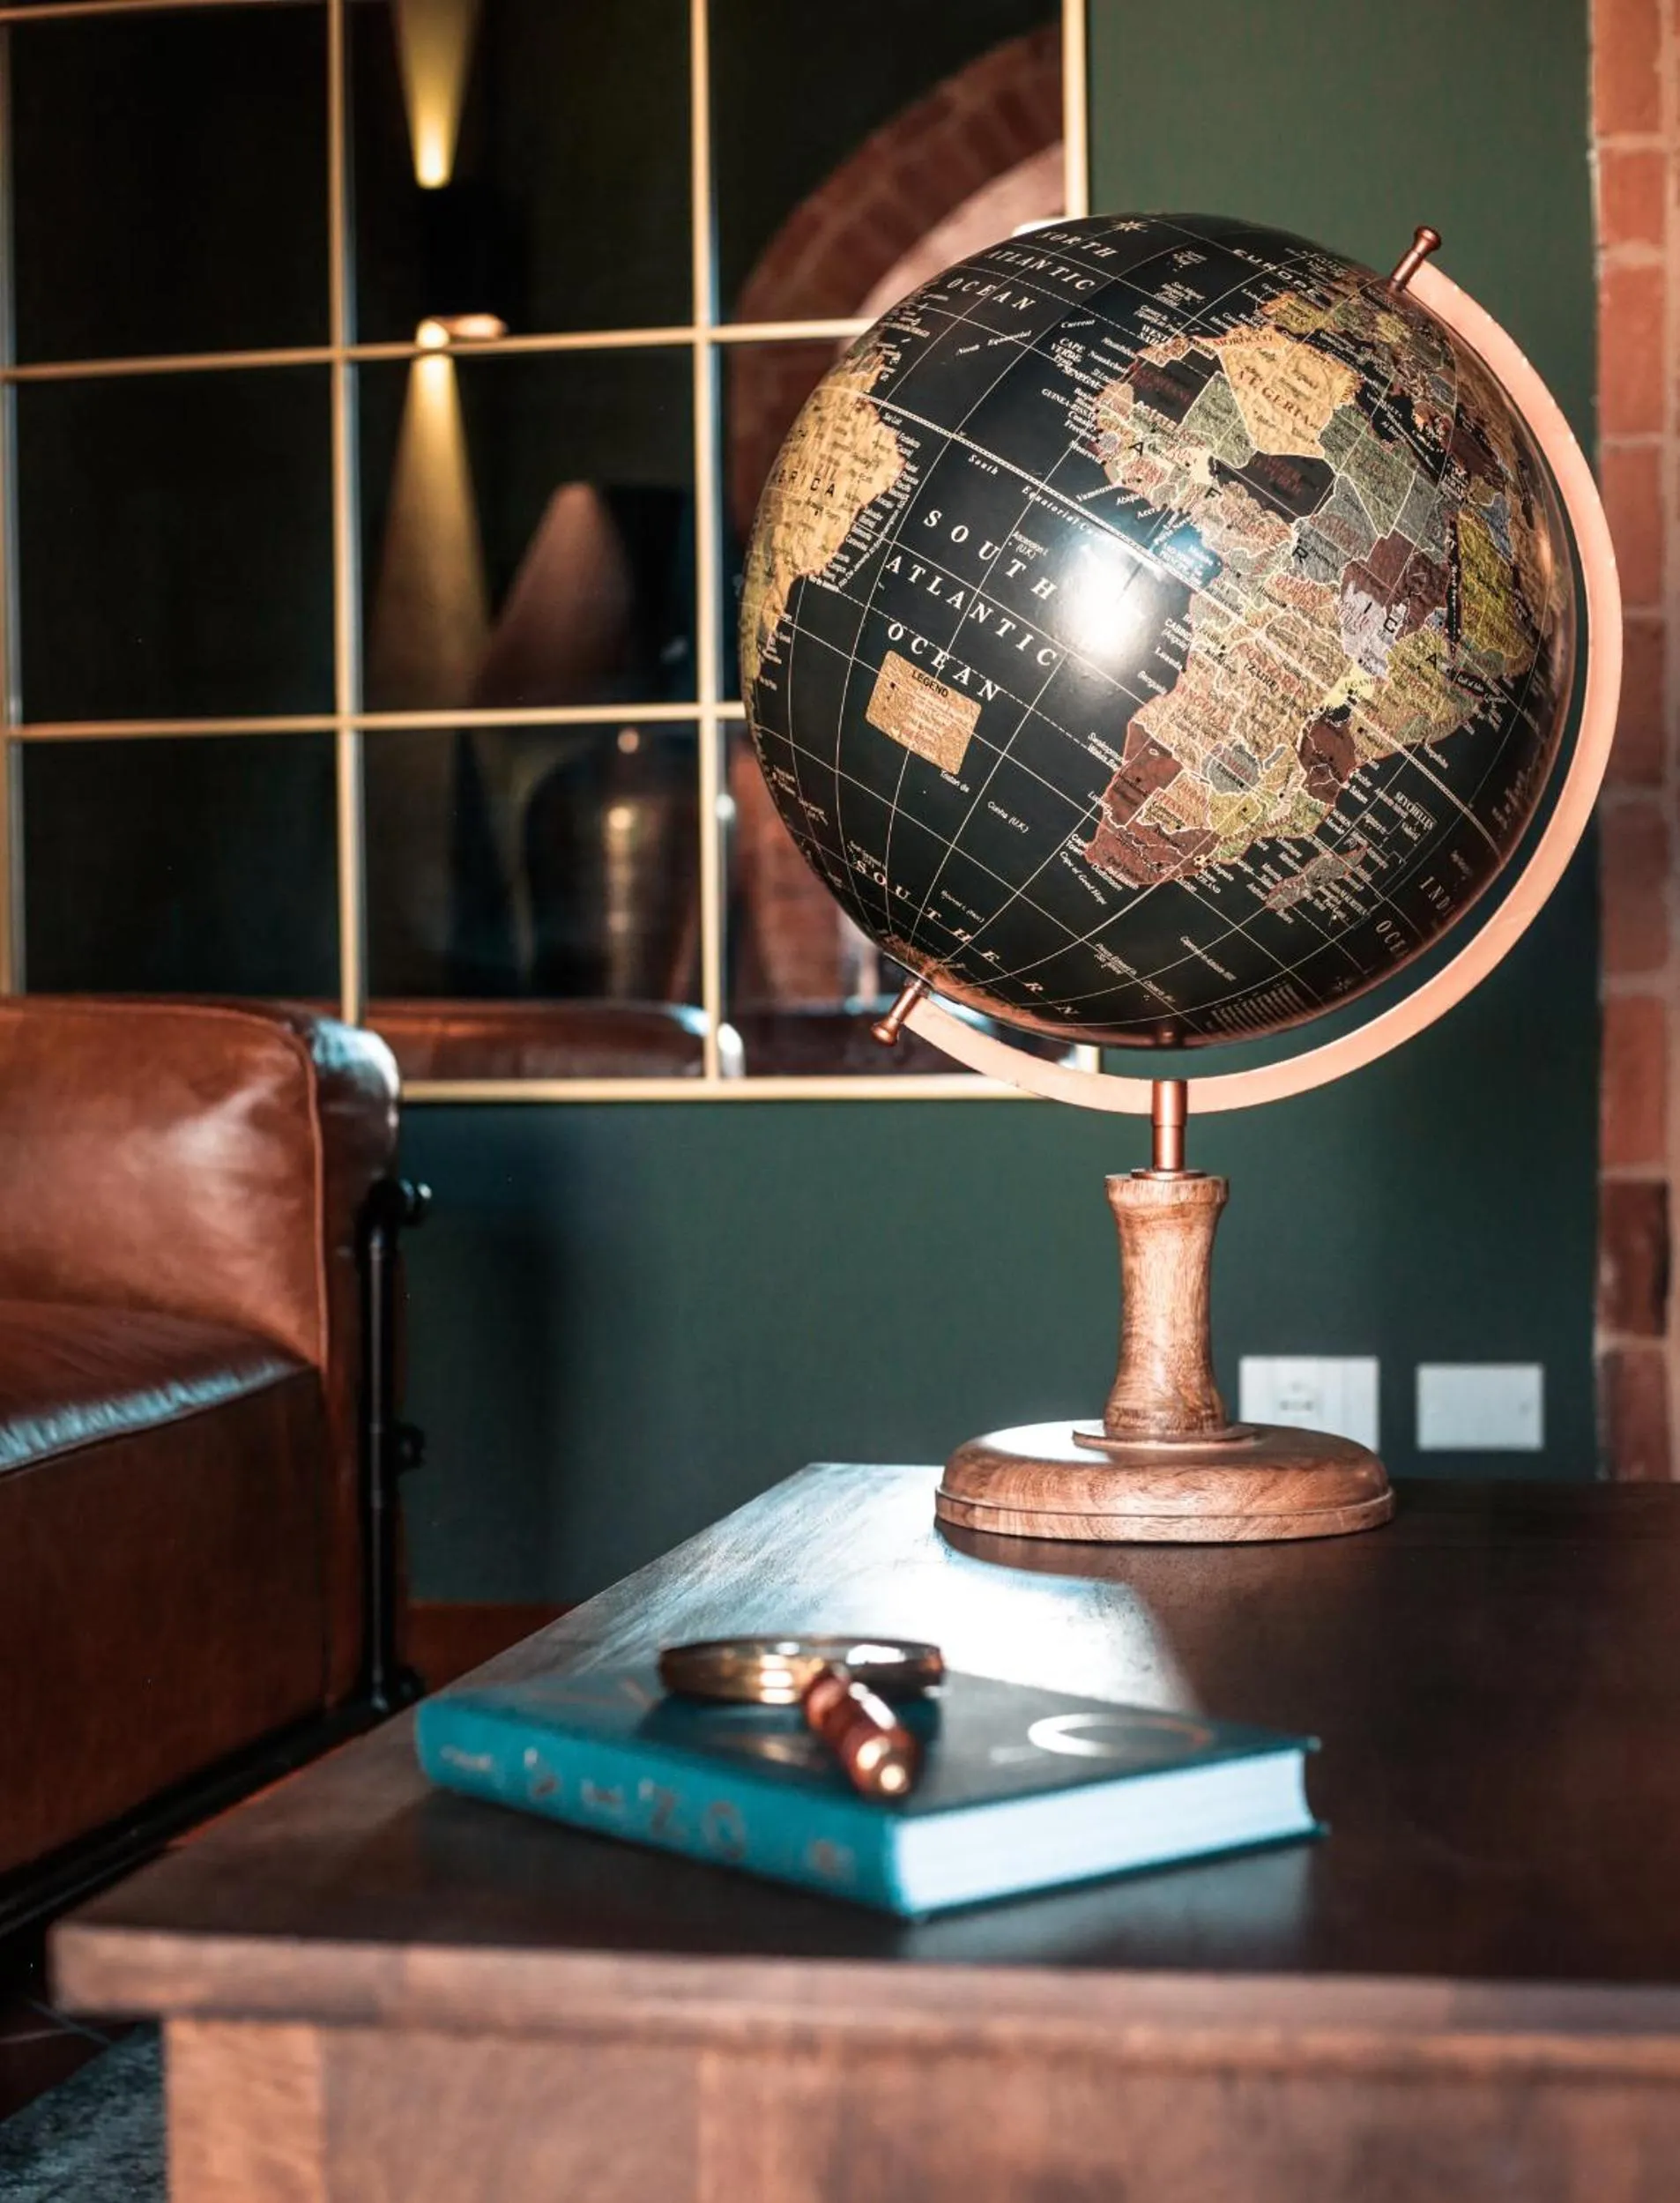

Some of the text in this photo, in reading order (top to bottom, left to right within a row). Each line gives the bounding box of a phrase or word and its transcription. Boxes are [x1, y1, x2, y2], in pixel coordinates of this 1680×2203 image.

[985, 249, 1096, 291] ATLANTIC
[1036, 231, 1119, 258] NORTH
[947, 278, 1037, 311] OCEAN
[968, 454, 999, 476] South
[1022, 485, 1078, 527] Equatorial
[924, 510, 1058, 600] SOUTH
[886, 555, 1058, 666] ATLANTIC
[888, 622, 1002, 701] OCEAN
[911, 670, 949, 698] LEGEND
